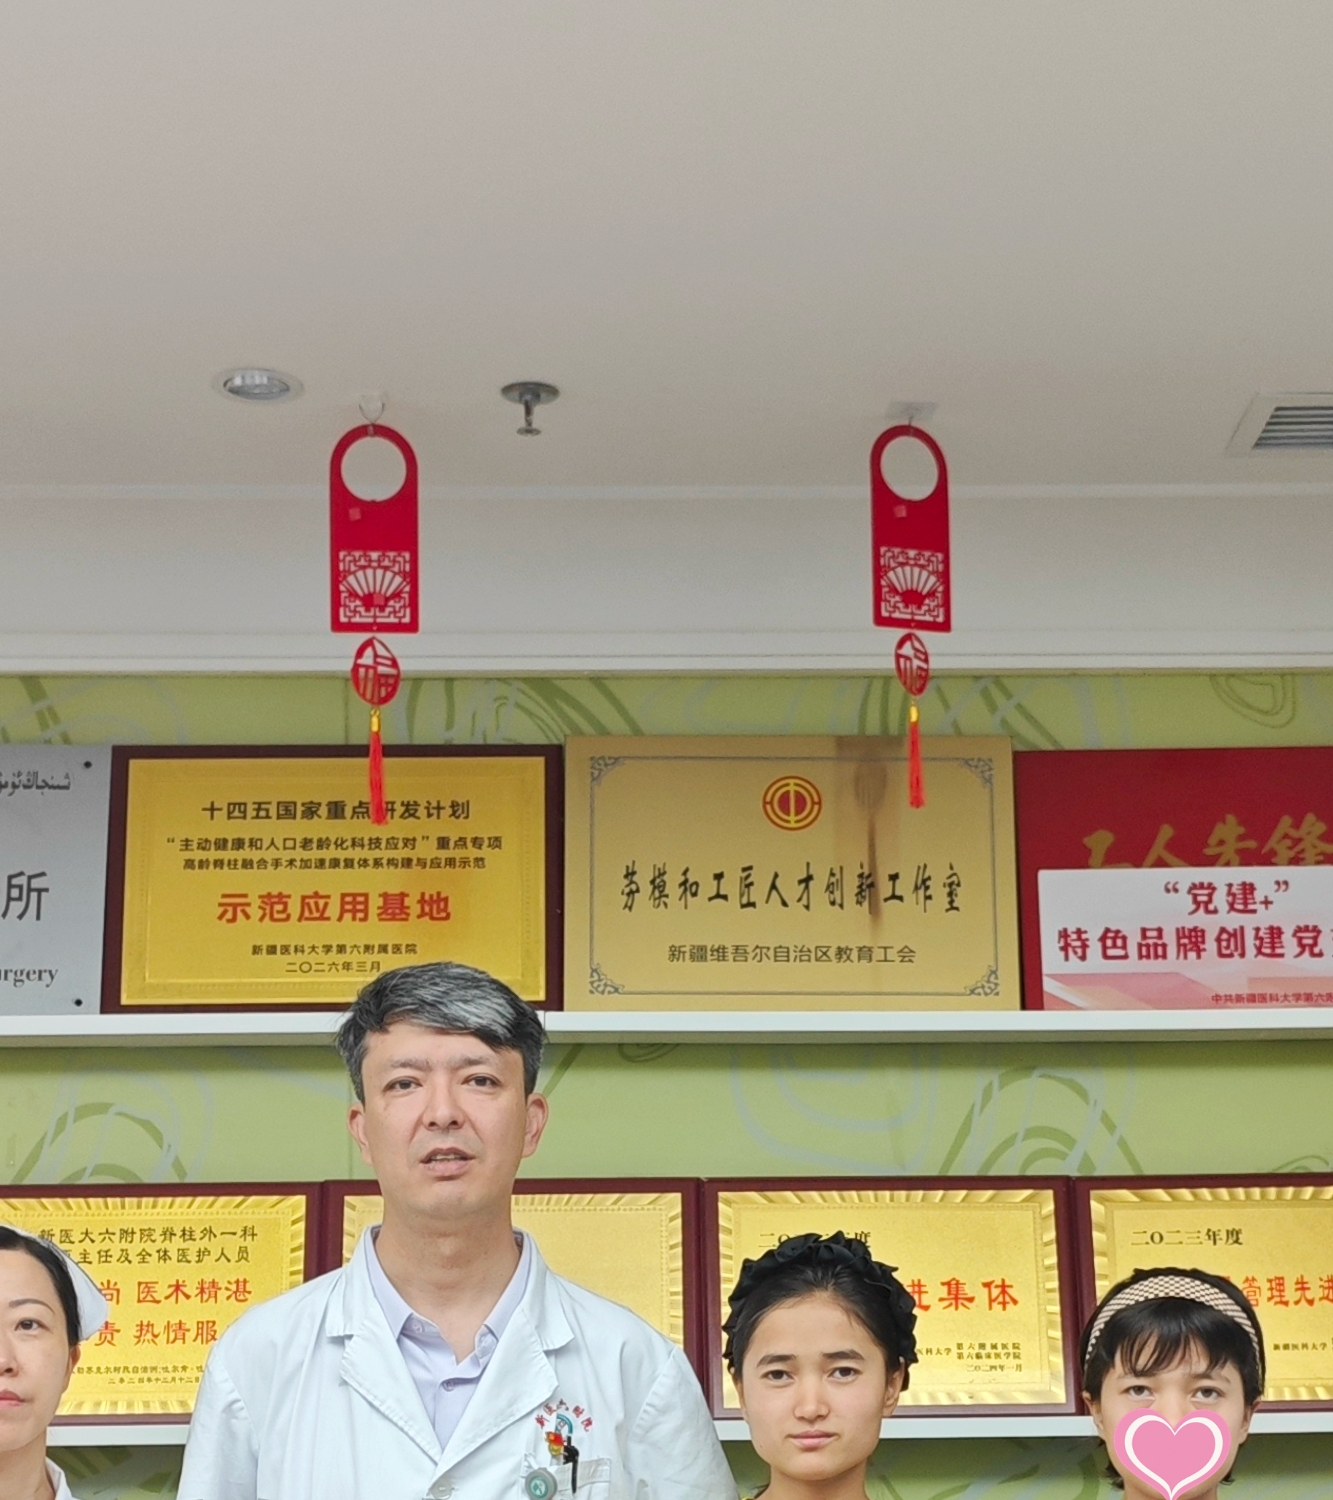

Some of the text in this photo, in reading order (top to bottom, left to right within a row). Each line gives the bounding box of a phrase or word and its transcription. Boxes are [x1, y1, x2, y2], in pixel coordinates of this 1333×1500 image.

[620, 860, 964, 913] 劳模和工匠人才创新工作室
[217, 891, 453, 924] 示范应用基地
[252, 943, 418, 957] 新疆医科大学第六附属医院
[667, 944, 917, 964] 新疆维吾尔自治区教育工会
[66, 1246, 251, 1265] 主任及全体医护人员
[137, 1278, 253, 1305] 医术精湛
